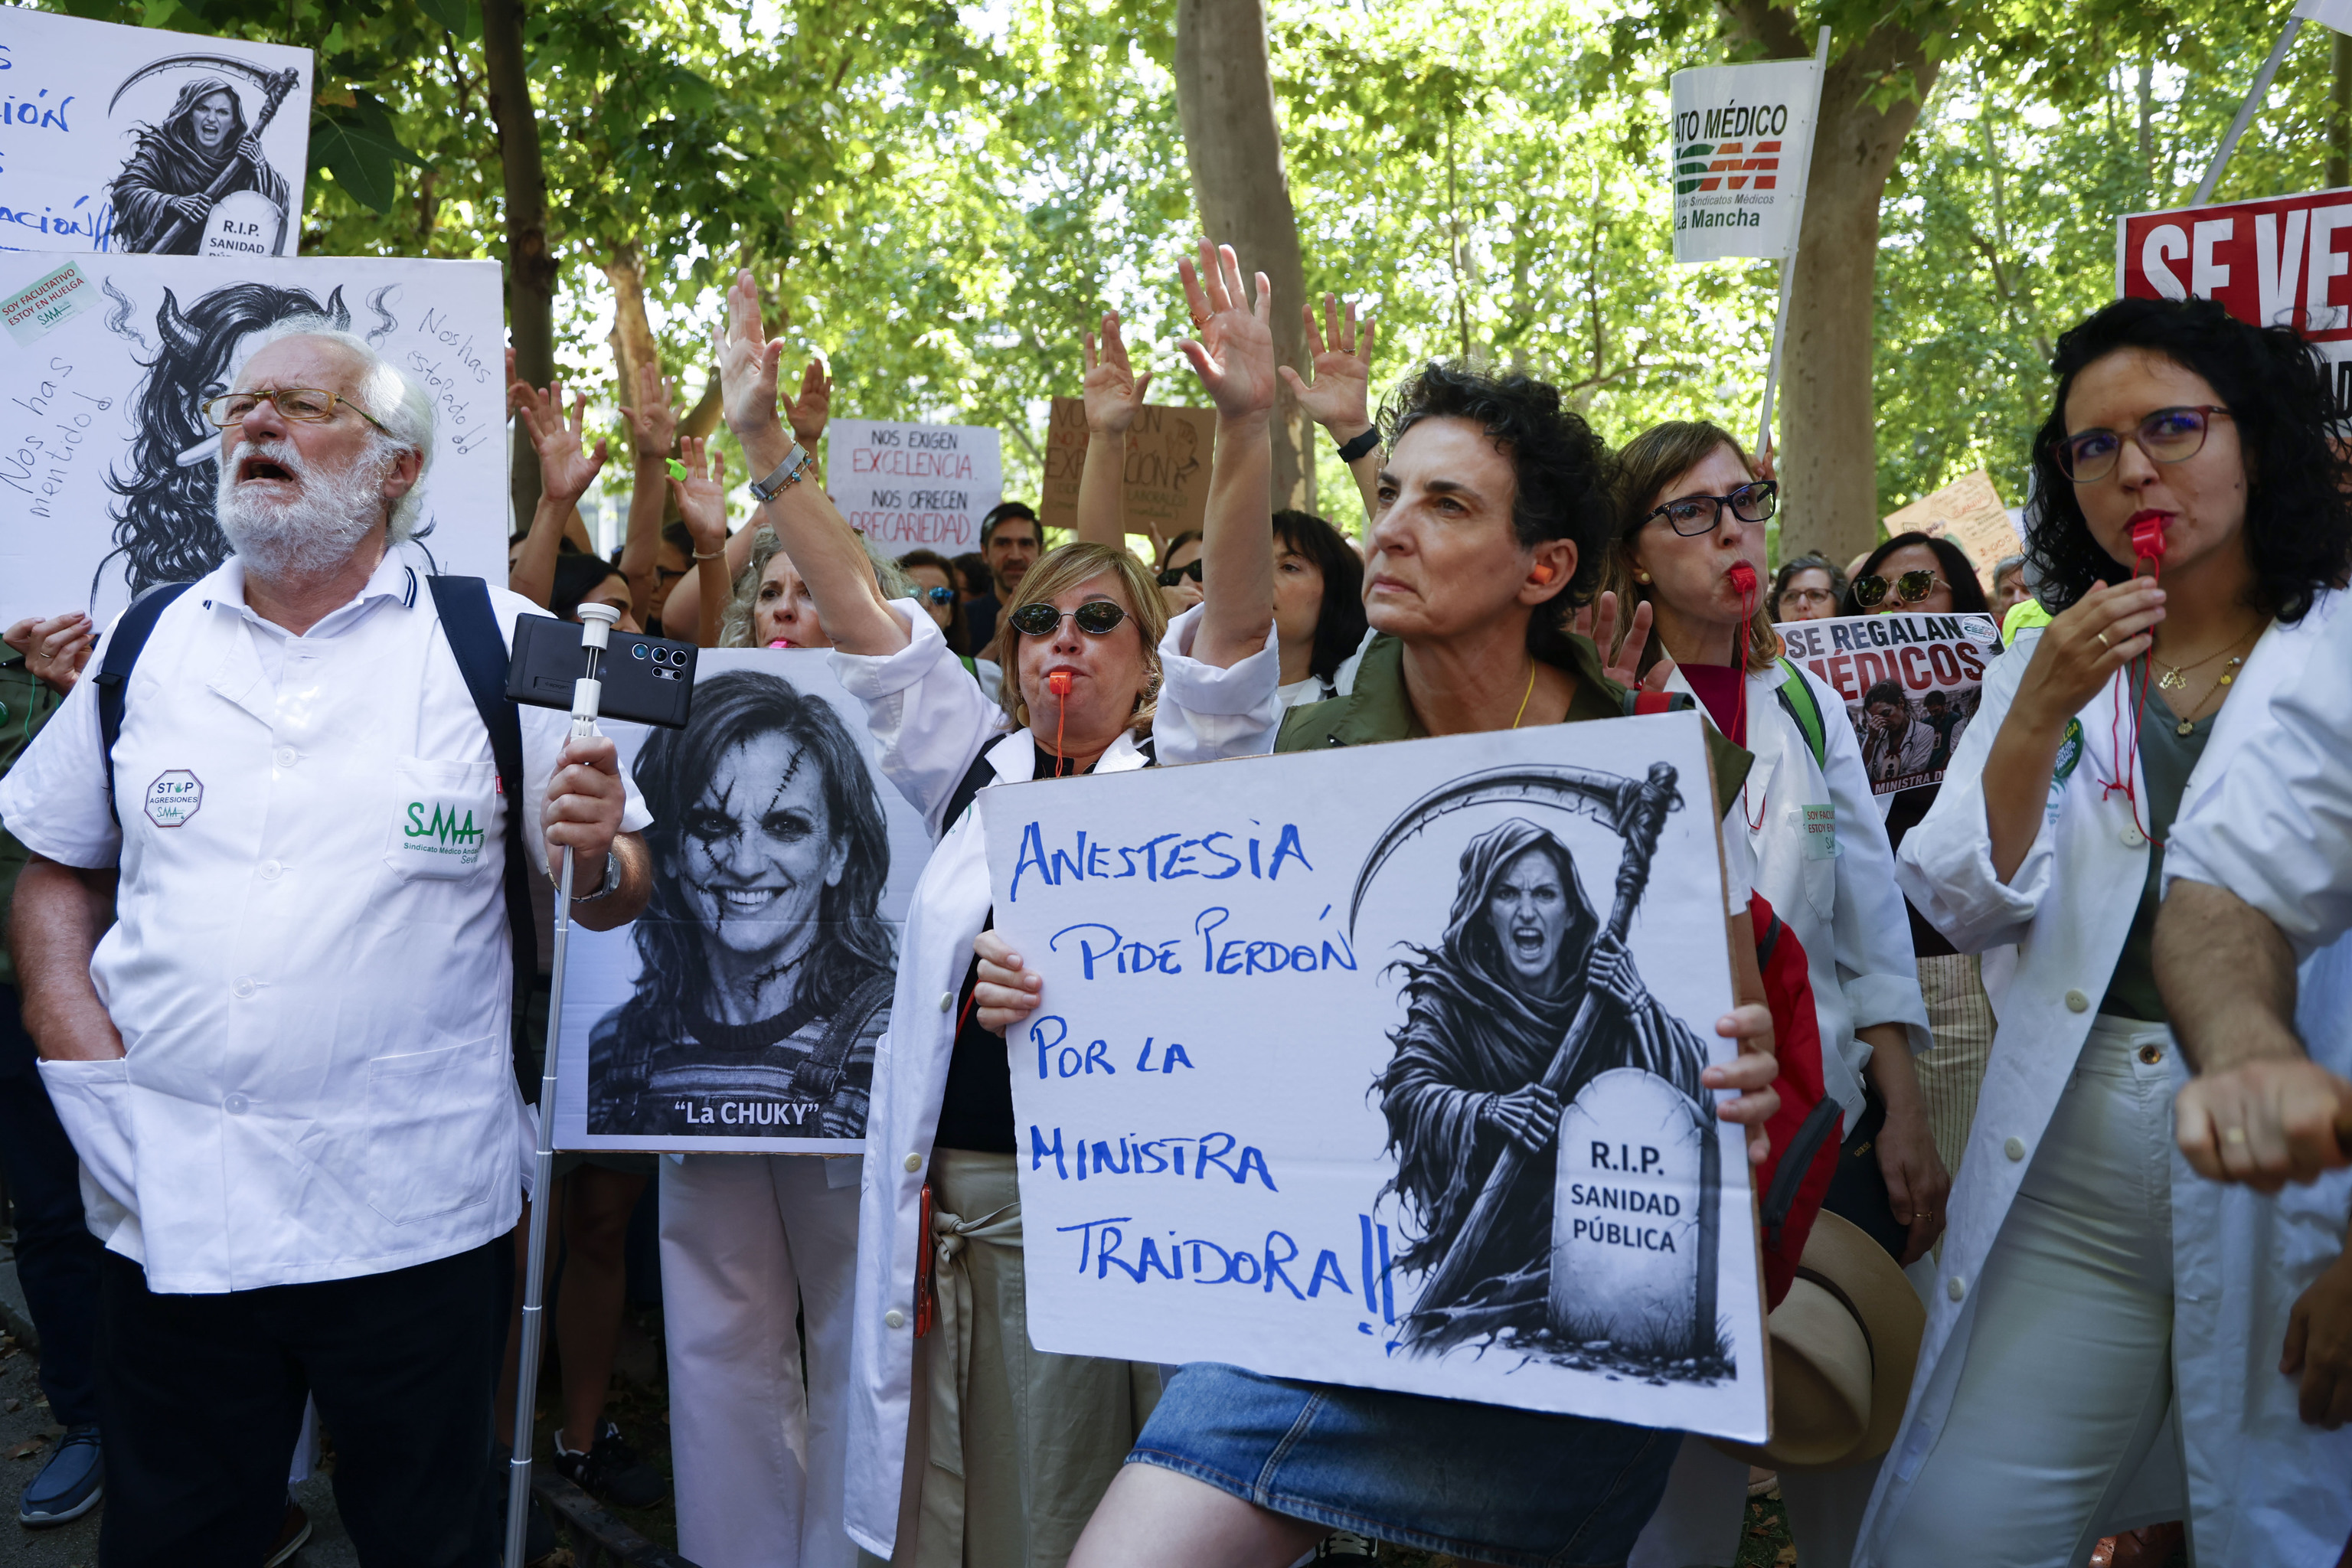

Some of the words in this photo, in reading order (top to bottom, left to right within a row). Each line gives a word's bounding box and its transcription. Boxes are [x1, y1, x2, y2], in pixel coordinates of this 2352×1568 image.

[1704, 99, 1788, 139] MÉDICO
[1690, 195, 1732, 207] Sindicatos
[1734, 194, 1775, 205] Médicos
[1691, 207, 1760, 229] Mancha
[209, 237, 265, 254] SANIDAD
[223, 219, 260, 237] R.I.P.
[2141, 217, 2233, 300] SE
[2255, 202, 2352, 331] VE
[2, 300, 20, 316] SOY
[19, 268, 76, 305] FACULTATIVO
[8, 305, 35, 326] ESTOY
[34, 297, 50, 310] EN
[48, 277, 85, 302] HUELGA
[37, 305, 69, 325] SMA
[418, 307, 460, 346] Nos
[457, 335, 491, 384] has
[11, 357, 73, 416] has
[871, 430, 900, 446] NOS
[908, 430, 958, 449] EXIGEN
[0, 436, 44, 494] Nos
[871, 490, 902, 508] NOS
[908, 490, 968, 510] OFRECEN
[1785, 626, 1825, 659] SE
[1829, 616, 1966, 652] REGALAN
[1874, 773, 1930, 795] MINISTRA
[156, 806, 183, 818] SMA
[403, 801, 485, 847] SMA
[1807, 811, 1818, 821] SOY
[1808, 823, 1826, 834] ESTOY
[403, 842, 438, 853] Sindicato
[439, 847, 462, 855] Médico
[1194, 903, 1359, 976] PERDÓN
[1029, 1014, 1116, 1080] POR
[1135, 1035, 1195, 1073] LA
[1591, 1140, 1664, 1176] R.I.P.
[1571, 1183, 1681, 1217] SANIDAD
[1573, 1215, 1677, 1254] PÚBLICA
